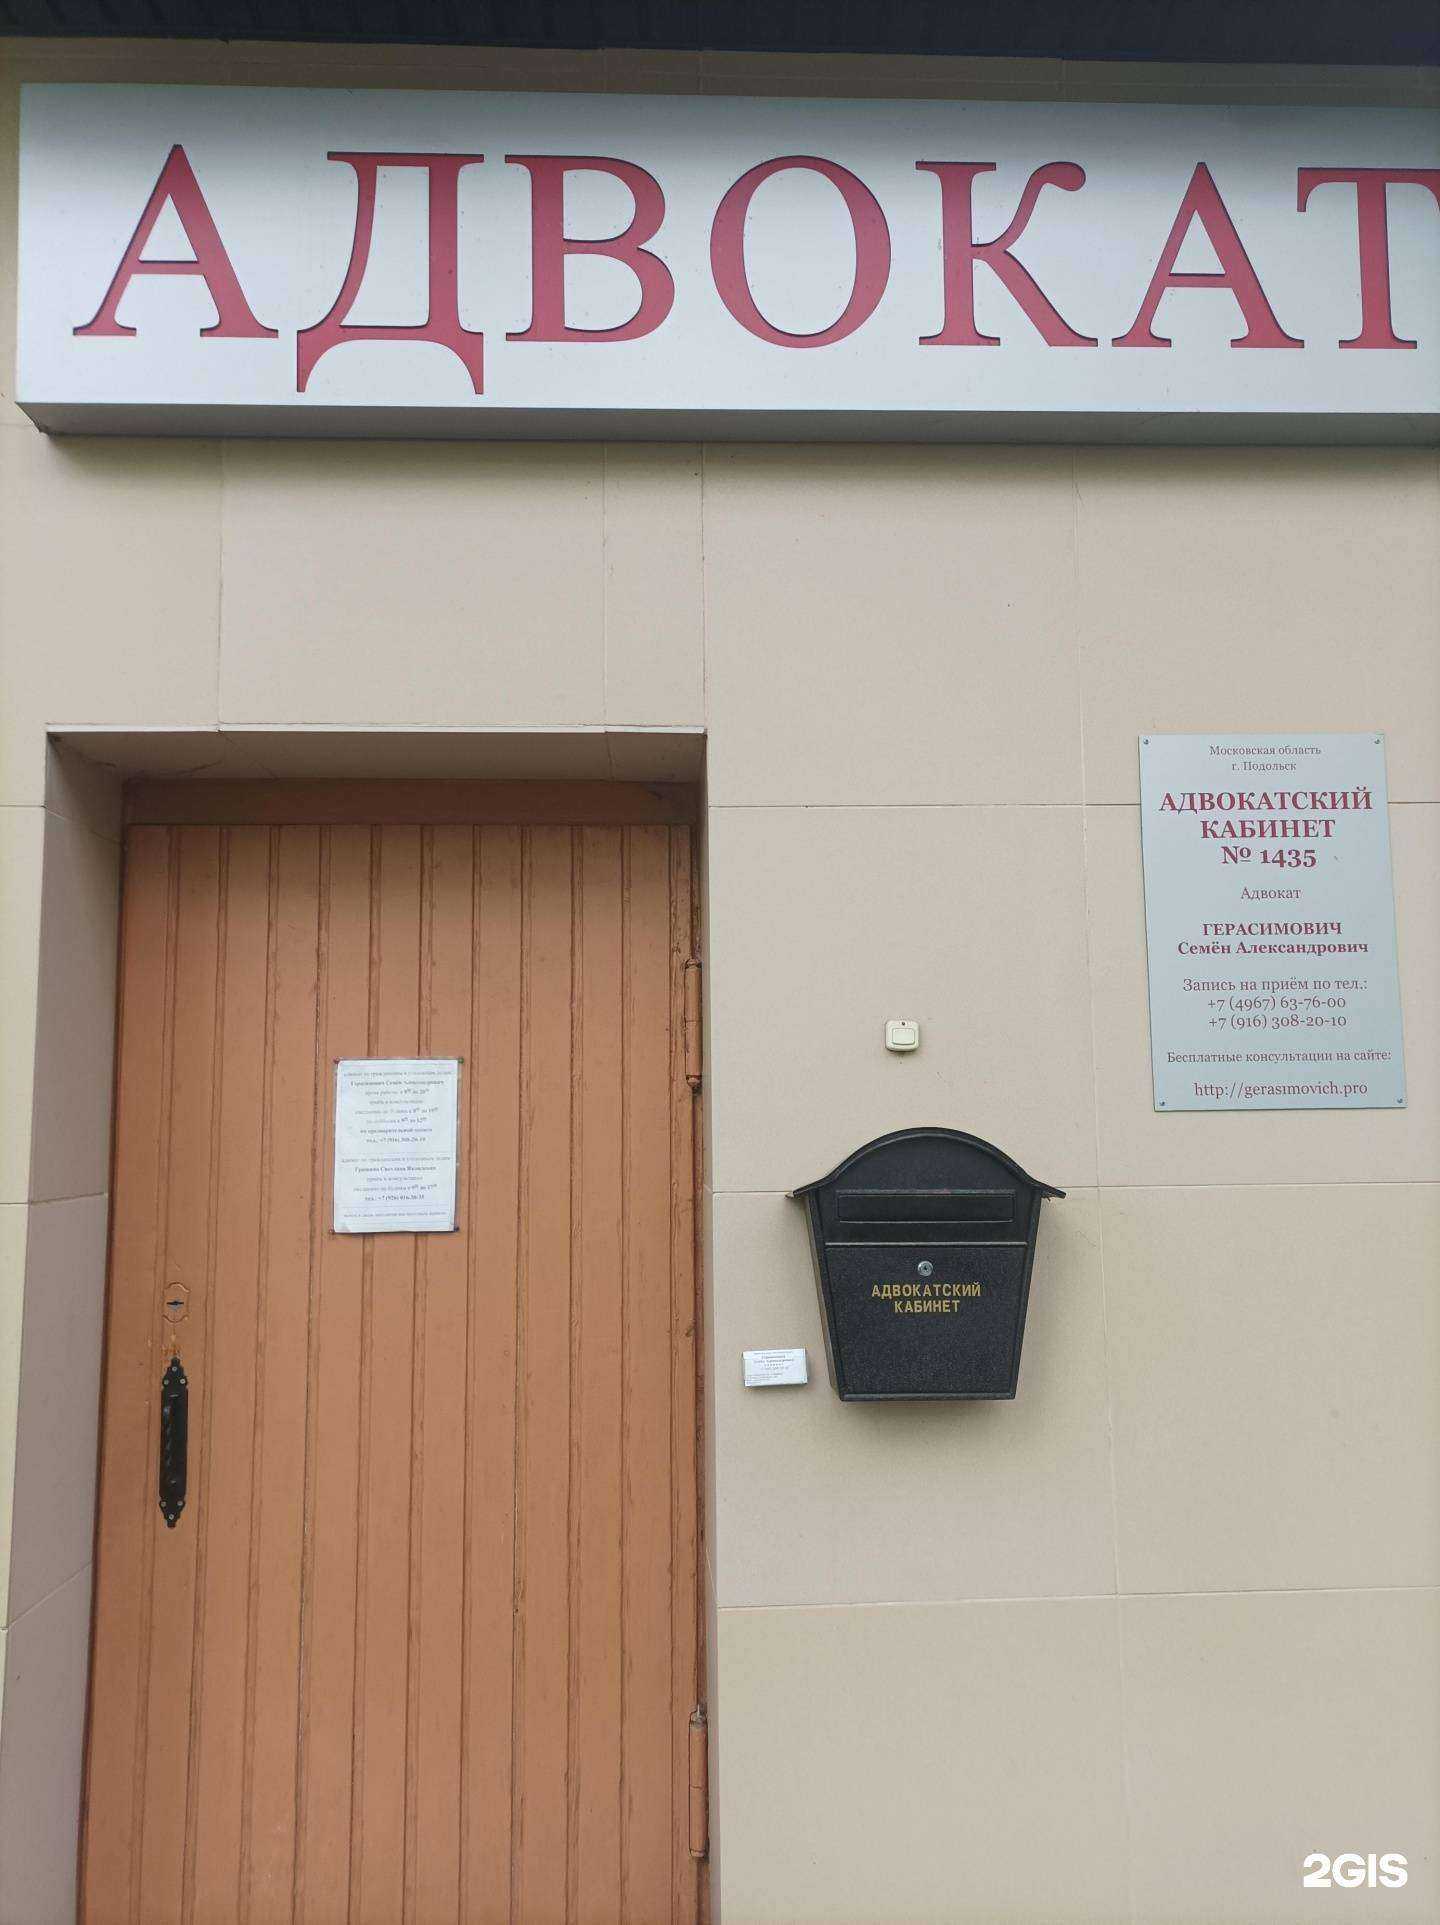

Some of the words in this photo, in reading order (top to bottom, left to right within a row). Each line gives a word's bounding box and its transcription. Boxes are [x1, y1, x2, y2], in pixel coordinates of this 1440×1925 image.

[73, 143, 1440, 395] АДВОКАТ
[1209, 745, 1275, 756] Московская
[1279, 745, 1321, 756] область
[1232, 763, 1240, 771] г.
[1243, 761, 1297, 772] Подольск
[1158, 786, 1373, 814] АДВОКАТСКИЙ
[1200, 819, 1336, 840] КАБИНЕТ
[1221, 845, 1252, 865] №
[1260, 849, 1317, 868] 1435
[1240, 887, 1302, 902] Адвокат
[1203, 922, 1342, 936] ГЕРАСИМОВИЧ
[1178, 941, 1231, 955] Семён
[1235, 941, 1368, 956] Александрович
[1183, 979, 1236, 992] Запись
[1240, 980, 1257, 991] на
[1262, 977, 1309, 993] приём
[1313, 980, 1330, 990] по
[1335, 979, 1368, 990] тел.:
[1208, 999, 1226, 1012] +7
[1228, 996, 1277, 1012] (4967)
[1281, 996, 1346, 1011] 63-76-00
[1208, 1017, 1227, 1031] +7
[1231, 1014, 1270, 1031] (916)
[1272, 1014, 1348, 1030] 308-20-10
[1167, 1051, 1244, 1063] Бесплатные
[1246, 1051, 1332, 1064] консультации
[1337, 1052, 1351, 1062] на
[1355, 1049, 1392, 1062] сайте:
[1193, 1081, 1368, 1100] http://gerasimovich.pro
[871, 1281, 981, 1300] АДВОКАТСКИЙ
[894, 1300, 960, 1313] КАБИНЕТ
